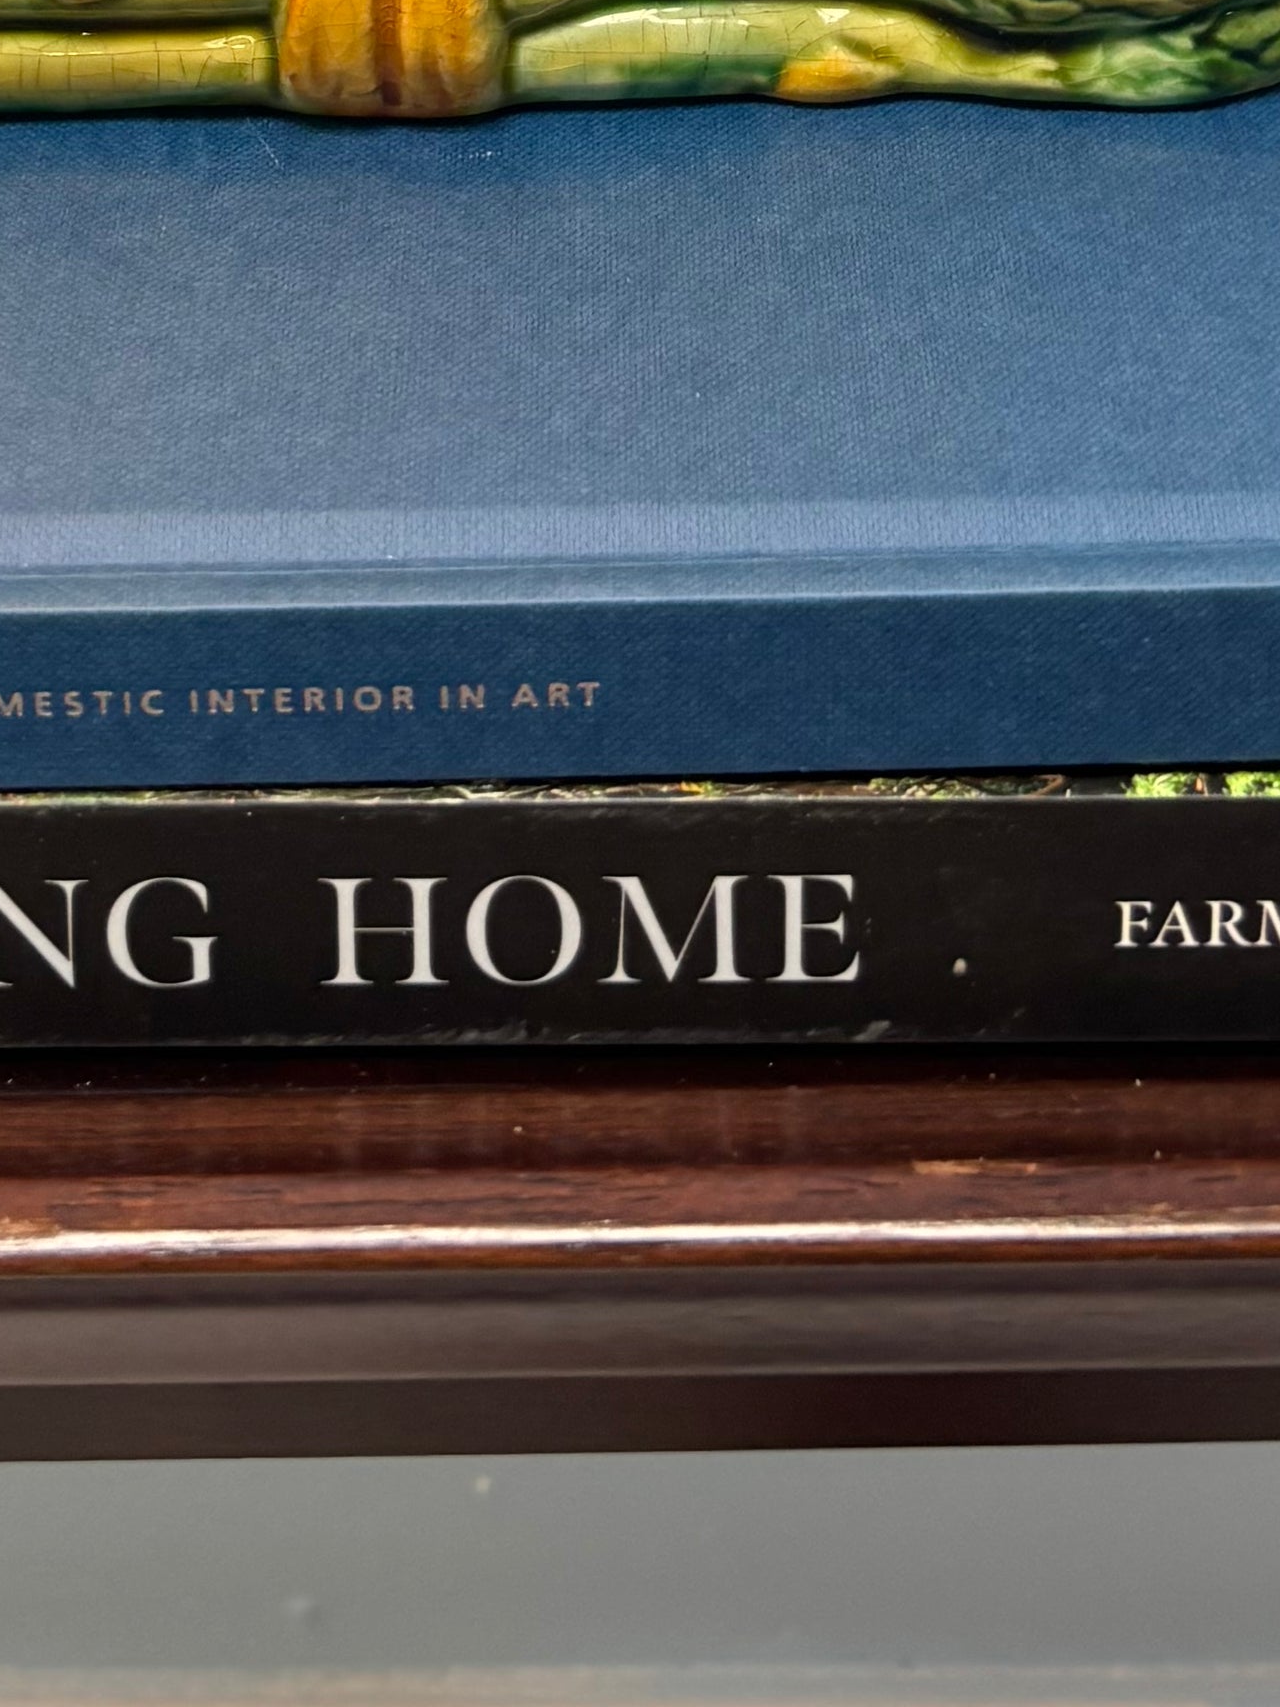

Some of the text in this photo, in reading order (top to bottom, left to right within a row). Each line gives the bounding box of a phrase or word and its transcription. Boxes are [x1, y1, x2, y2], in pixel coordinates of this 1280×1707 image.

[189, 686, 415, 715] INTERIOR
[440, 684, 487, 710] IN
[511, 681, 602, 708] ART
[320, 875, 861, 985] HOME
